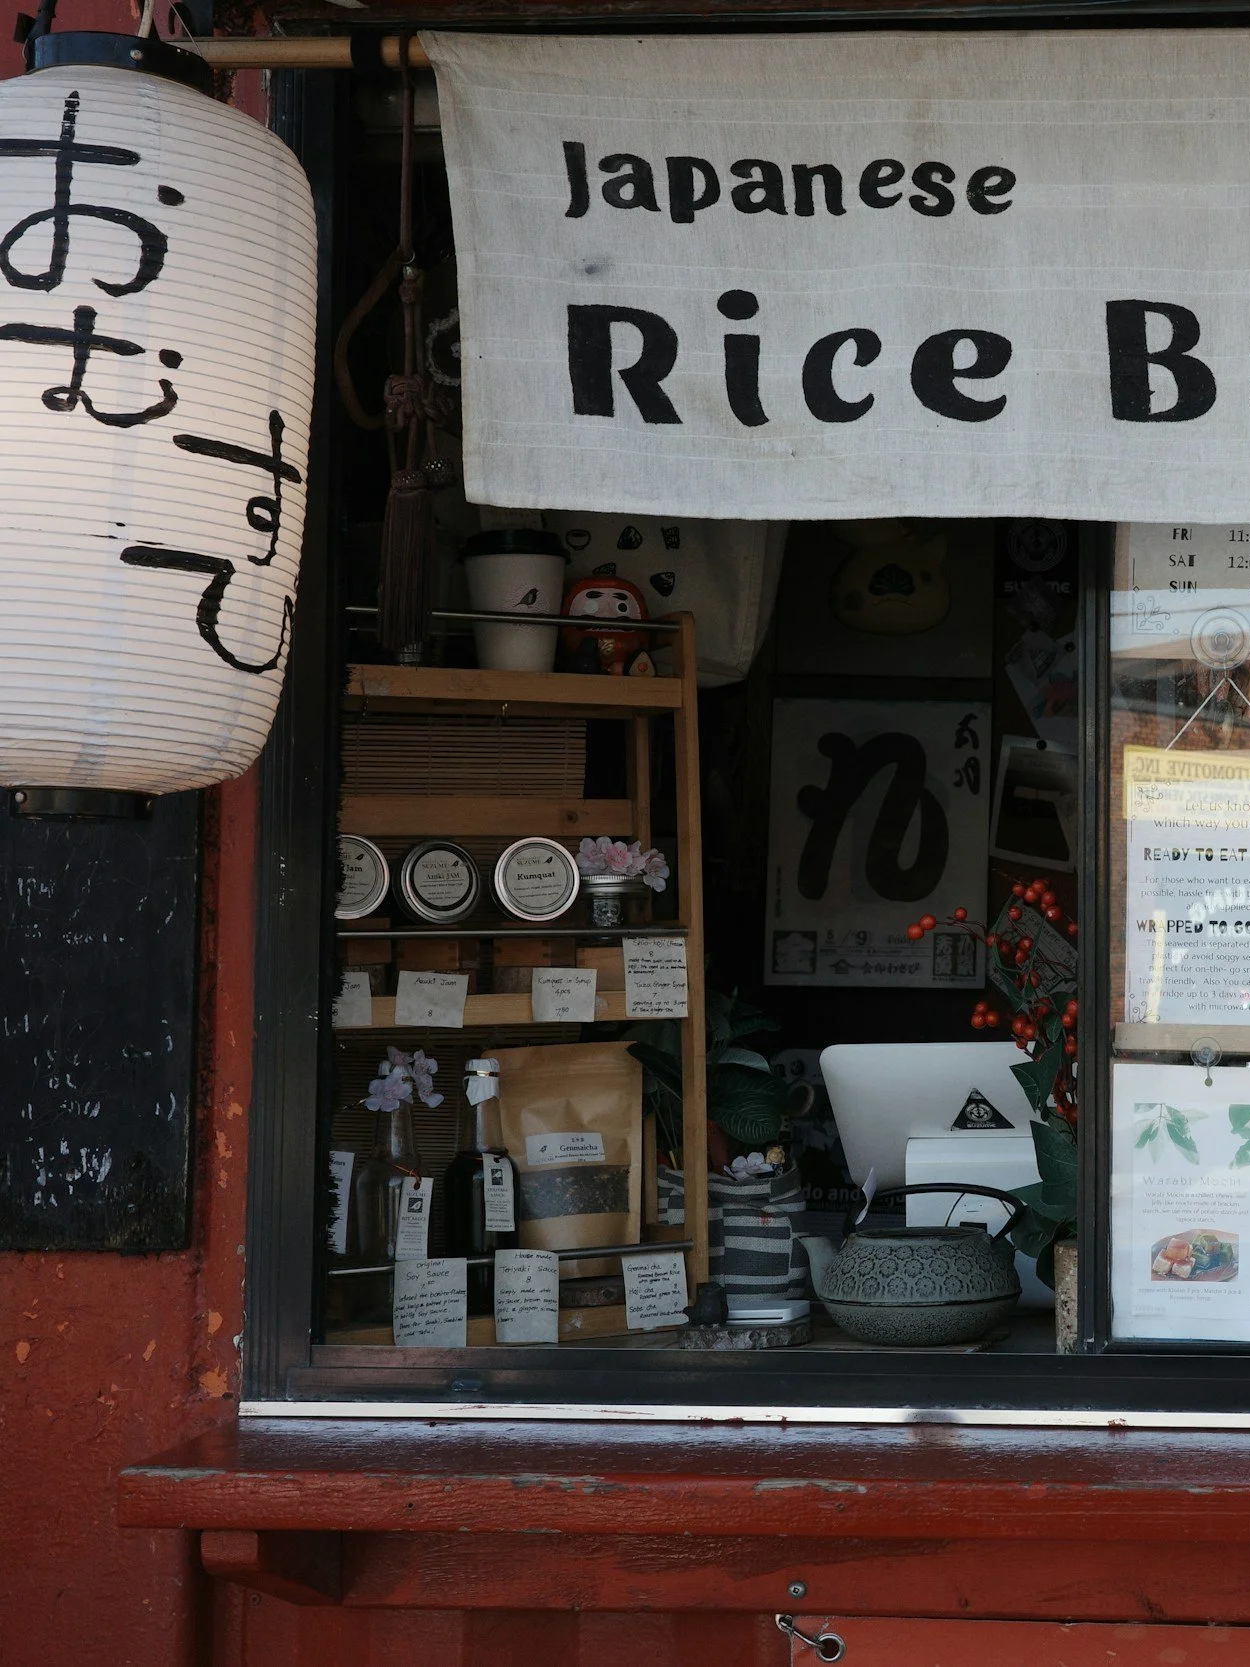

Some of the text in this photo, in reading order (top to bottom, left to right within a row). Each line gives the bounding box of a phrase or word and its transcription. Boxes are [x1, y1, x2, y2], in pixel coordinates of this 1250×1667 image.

[563, 140, 1016, 223] Japanese
[567, 289, 1013, 427] Rice
[1173, 528, 1192, 541] FRI
[1169, 554, 1196, 567] SAT
[1169, 581, 1197, 594] SUN
[1185, 801, 1205, 812] Let
[1209, 802, 1223, 812] us
[1153, 817, 1191, 828] which
[1195, 819, 1222, 830] way
[1224, 819, 1249, 830] you
[1144, 847, 1247, 862] READY TO EAT
[517, 872, 555, 881] Kumquat
[1137, 920, 1203, 933] WRAPPED
[1209, 920, 1227, 933] TO
[1209, 940, 1250, 950] separated
[559, 1143, 598, 1152] Genmaicha
